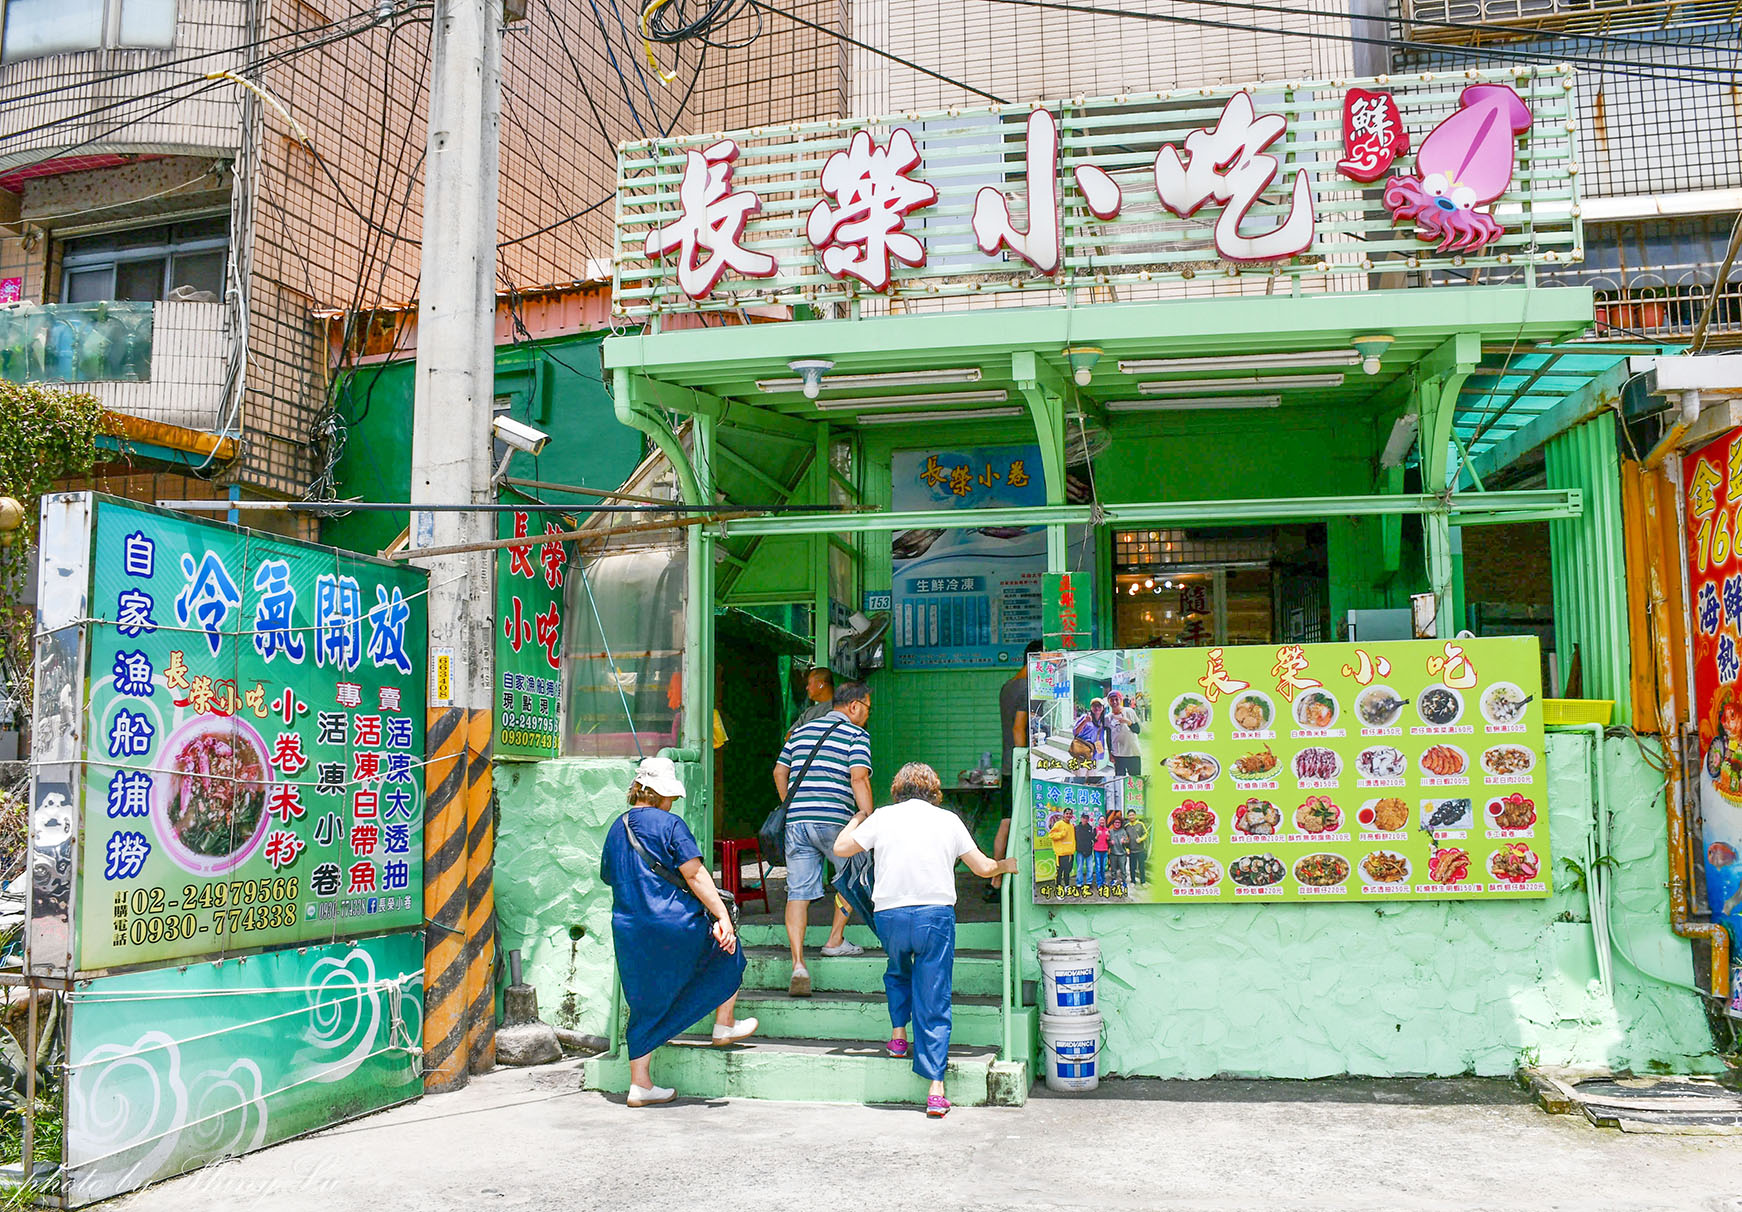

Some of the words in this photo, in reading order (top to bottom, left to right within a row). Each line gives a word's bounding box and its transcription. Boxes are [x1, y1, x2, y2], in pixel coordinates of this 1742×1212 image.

[1349, 93, 1395, 148] 鮮
[644, 90, 1316, 301] 長榮小吃
[920, 455, 1030, 497] 長榮小卷
[506, 510, 568, 590] 長榮
[916, 577, 975, 593] 生鮮冷凍
[174, 547, 413, 676] 冷氣開放
[870, 596, 890, 608] 153
[1058, 574, 1078, 649] 星期二公休
[102, 529, 159, 881] 自家漁船捕撈
[162, 650, 270, 721] 長榮小吃
[335, 681, 402, 712] 專賣
[1198, 641, 1479, 703] 長榮小吃
[263, 687, 308, 868] 小卷米粉
[311, 710, 349, 898] 活凍小卷
[347, 713, 381, 894] 活凍白帶魚
[381, 716, 413, 891] 活凍大透抽
[112, 888, 129, 948] 訂購電話
[130, 905, 298, 947] 0930-774338
[131, 876, 300, 916] 02-24979566
